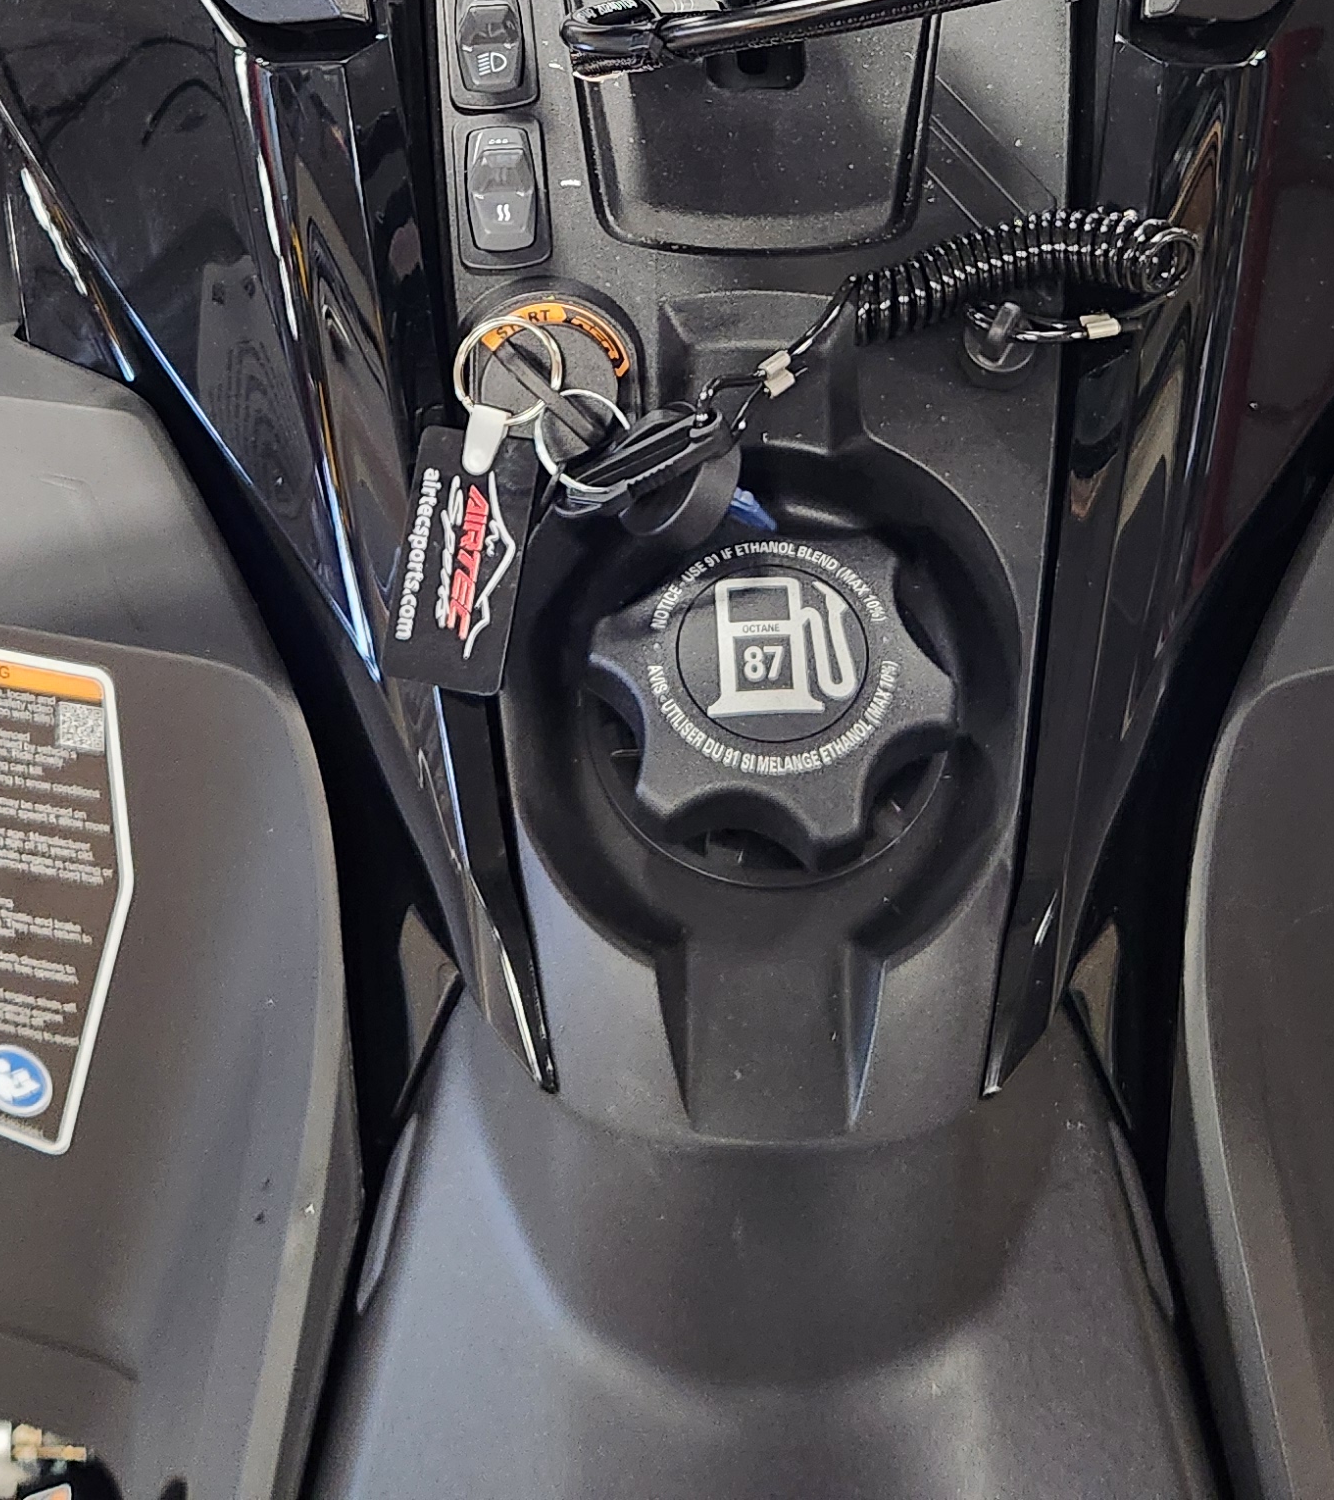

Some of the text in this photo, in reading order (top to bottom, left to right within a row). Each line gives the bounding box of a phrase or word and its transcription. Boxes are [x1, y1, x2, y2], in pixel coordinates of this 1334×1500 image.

[496, 309, 550, 339] STRT
[395, 467, 440, 641] airtecsports.com
[446, 485, 490, 640] AIRTEC
[651, 586, 682, 629] NOTICE
[683, 563, 708, 587] USE
[704, 553, 720, 569] 91
[720, 548, 733, 561] IF
[735, 541, 795, 556] ETHANOL
[797, 544, 838, 569] BLEND
[836, 566, 867, 597] (MAX
[742, 623, 781, 634] OCTANE
[743, 646, 785, 681] 87
[647, 664, 668, 697] AVIS
[661, 699, 704, 752] UTILISER
[703, 740, 724, 761] DU
[722, 750, 740, 768] 91
[741, 755, 756, 774] SI
